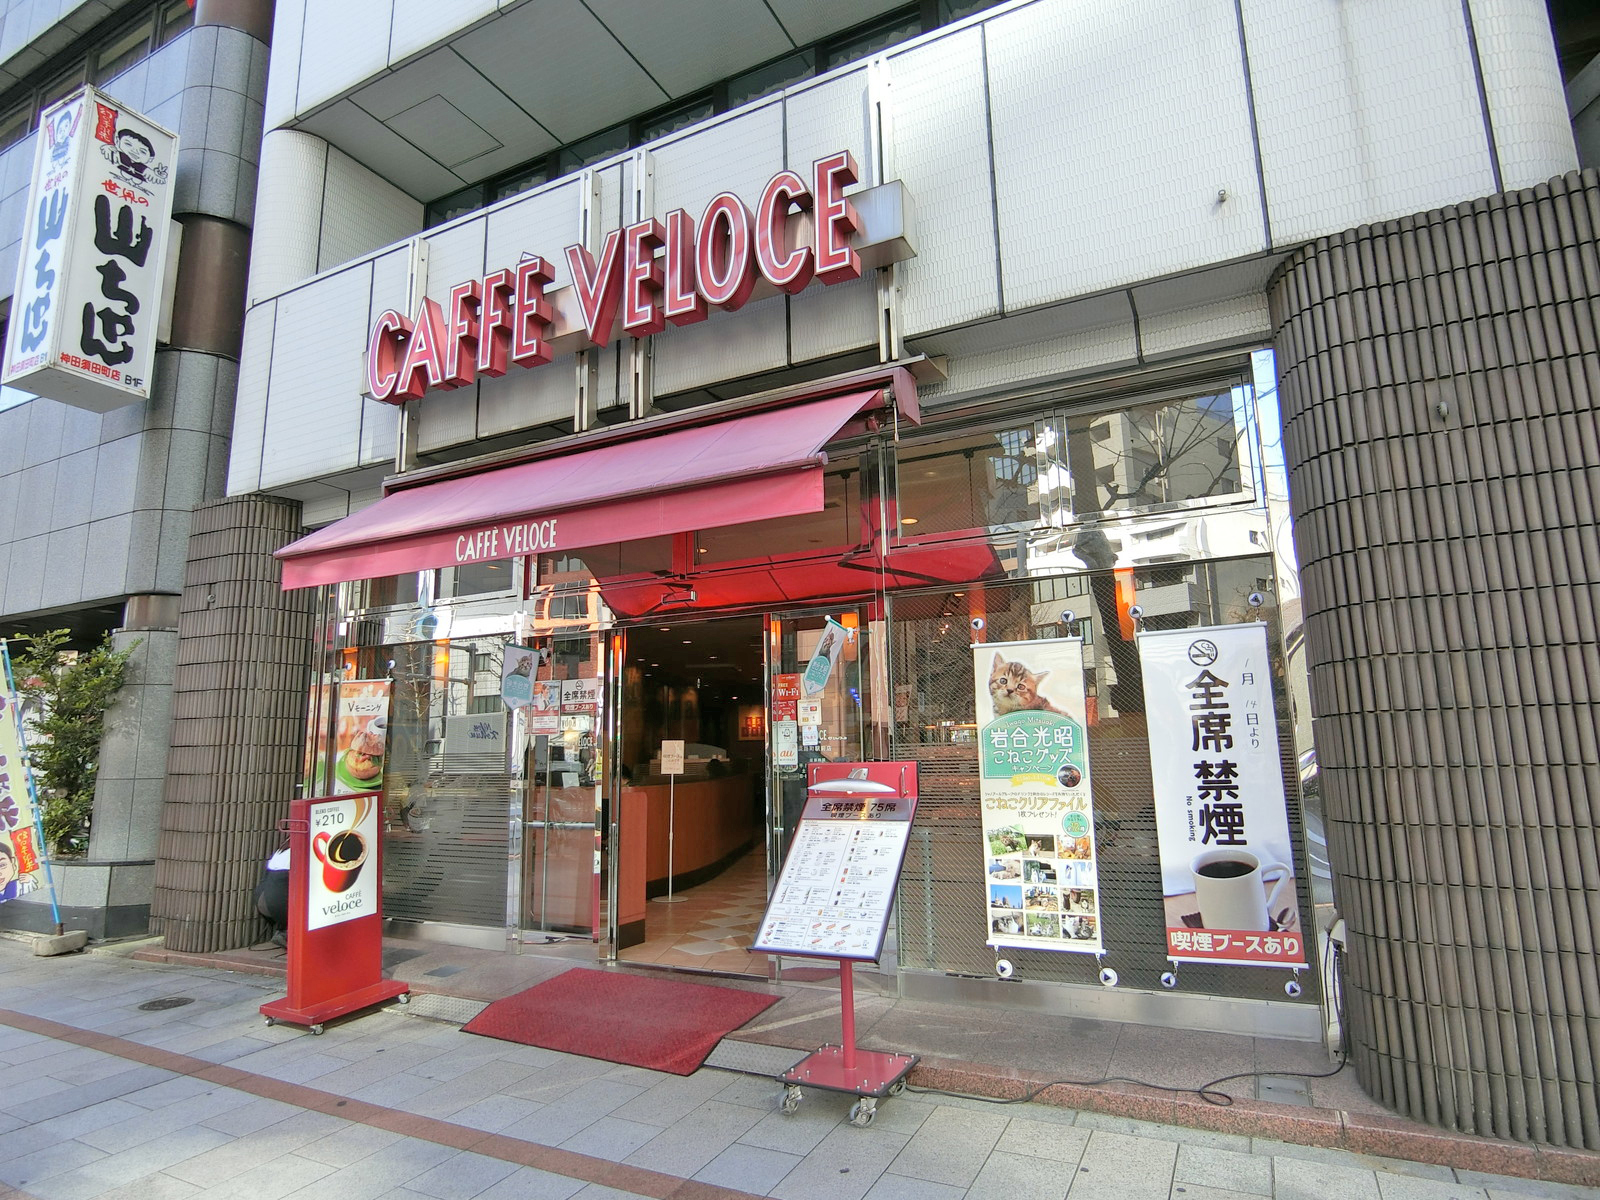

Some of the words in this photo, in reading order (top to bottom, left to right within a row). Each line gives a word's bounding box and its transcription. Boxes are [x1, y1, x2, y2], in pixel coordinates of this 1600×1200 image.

[101, 179, 149, 208] 世界の
[563, 149, 862, 349] VELOCE
[21, 186, 70, 354] 山ちゃん
[80, 194, 154, 367] 山ちゃん
[60, 352, 122, 381] 神田須田町店
[124, 374, 144, 388] B1F
[455, 526, 499, 562] CAFFÈ
[503, 519, 557, 553] VELOCE
[563, 689, 596, 701] 全席禁煙
[778, 687, 799, 697] Wi-Fi
[990, 726, 1074, 748] 岩合光昭
[779, 750, 794, 758] au
[993, 748, 1073, 764] こねこグッズ
[1185, 669, 1247, 846] 全席禁煙
[820, 802, 866, 812] 全席禁煙
[870, 802, 897, 812] 75席
[985, 797, 1088, 811] こねこクリアファイル
[1186, 795, 1193, 806] No
[315, 812, 345, 827] ¥210
[1188, 808, 1197, 842] smoking
[321, 898, 364, 916] veloce
[1170, 930, 1299, 956] 喫煙ブースあり
